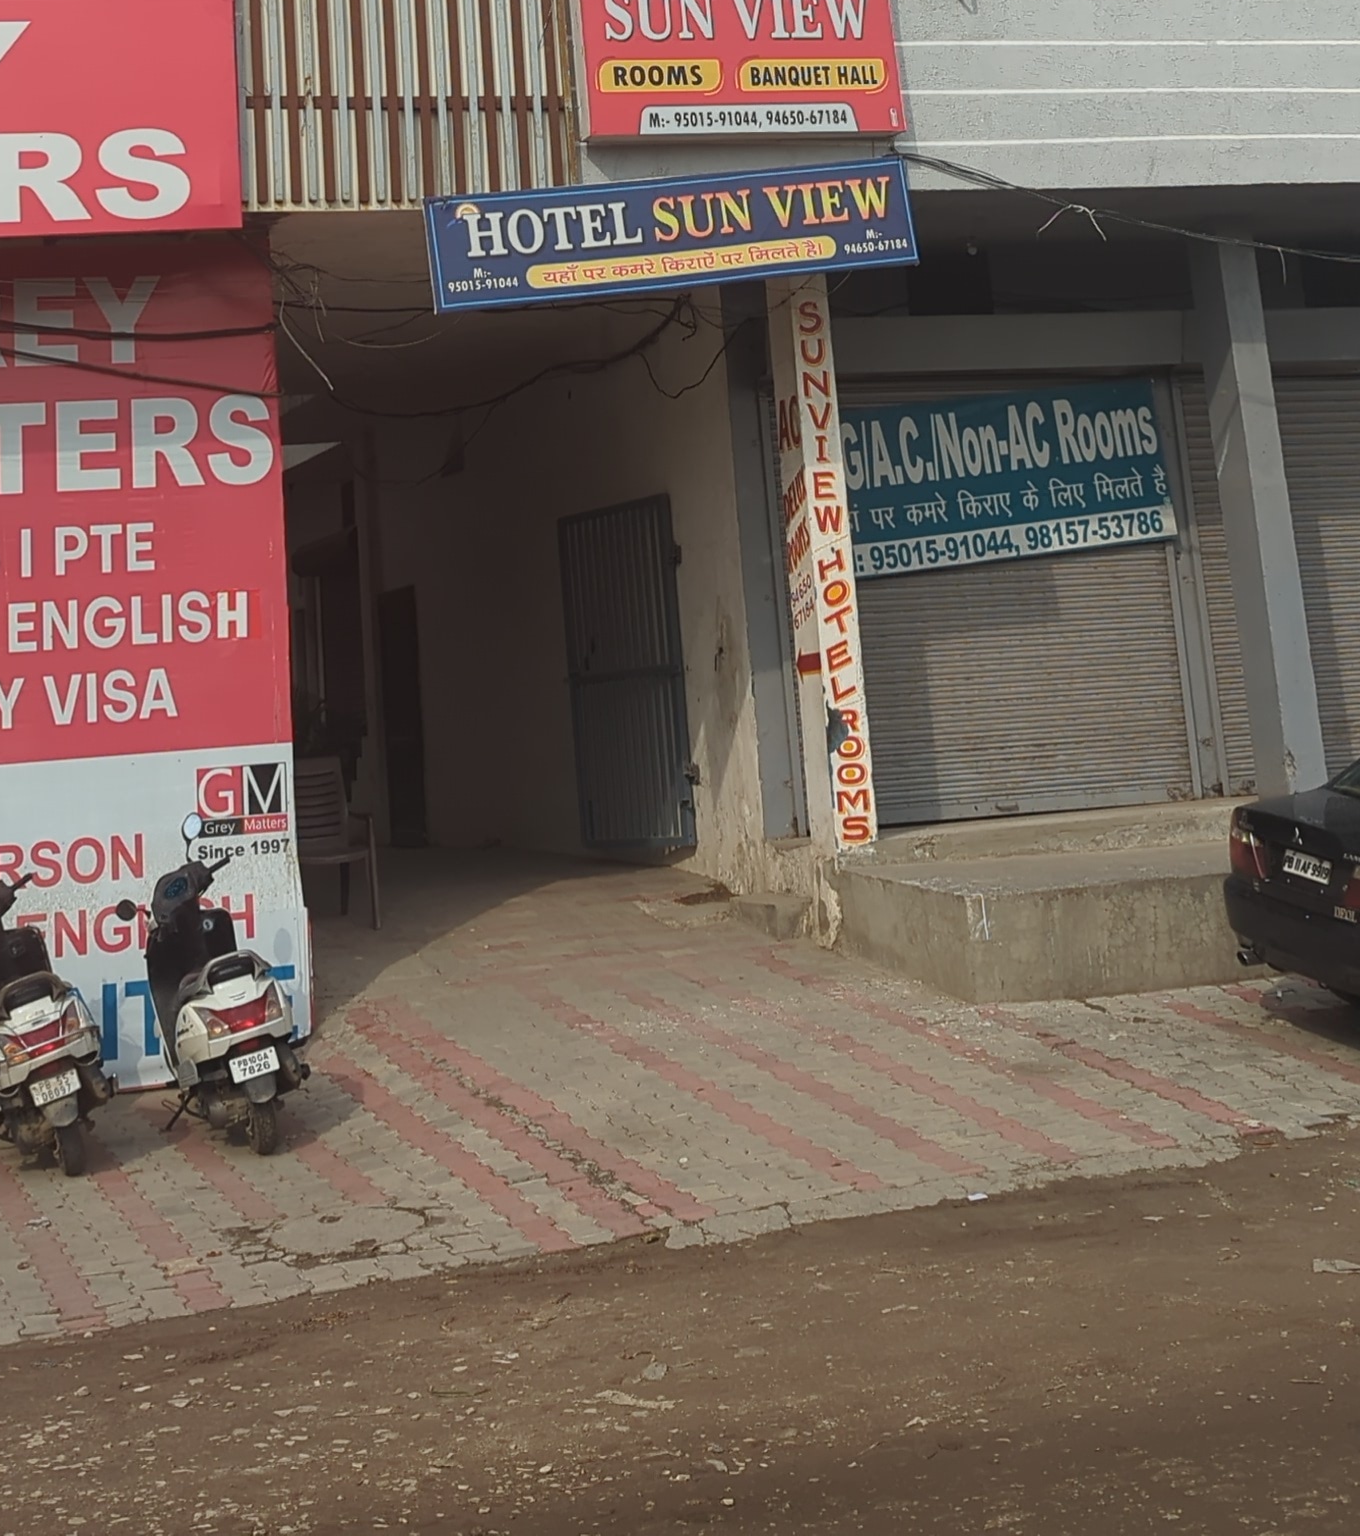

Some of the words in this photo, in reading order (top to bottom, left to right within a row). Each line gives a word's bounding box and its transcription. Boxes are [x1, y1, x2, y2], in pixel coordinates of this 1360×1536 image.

[613, 65, 704, 87] ROOMS
[750, 66, 831, 87] BANQUET
[838, 65, 879, 85] HALL
[674, 111, 763, 129] 95015-91044,
[766, 109, 848, 127] 94650-67184
[462, 201, 643, 258] HOTEL
[652, 188, 753, 243] SUN
[762, 175, 891, 229] VIEW
[582, 267, 606, 280] पर
[612, 258, 657, 277] कमरे
[721, 252, 744, 266] पर
[748, 242, 800, 263] मिलते
[843, 238, 908, 255] 94650-67184
[447, 276, 519, 294] 95015-91044
[1053, 398, 1159, 465] Rooms
[869, 506, 896, 531] पर
[903, 491, 949, 527] कमरे
[957, 489, 1014, 520] किराए
[1020, 480, 1039, 512] के
[1048, 478, 1087, 509] लिए
[1094, 466, 1144, 503] मिलते
[54, 521, 156, 576] PTE
[869, 528, 1021, 571] 95015-91044,
[1026, 508, 1165, 550] 98157-53786
[7, 590, 249, 654] ENGLISH
[42, 667, 179, 726] VISA
[199, 763, 287, 817] GM
[204, 822, 235, 835] Grey
[244, 818, 286, 832] Matters
[198, 845, 245, 860] Since
[251, 838, 290, 855] 1997
[240, 1061, 271, 1077] 7826
